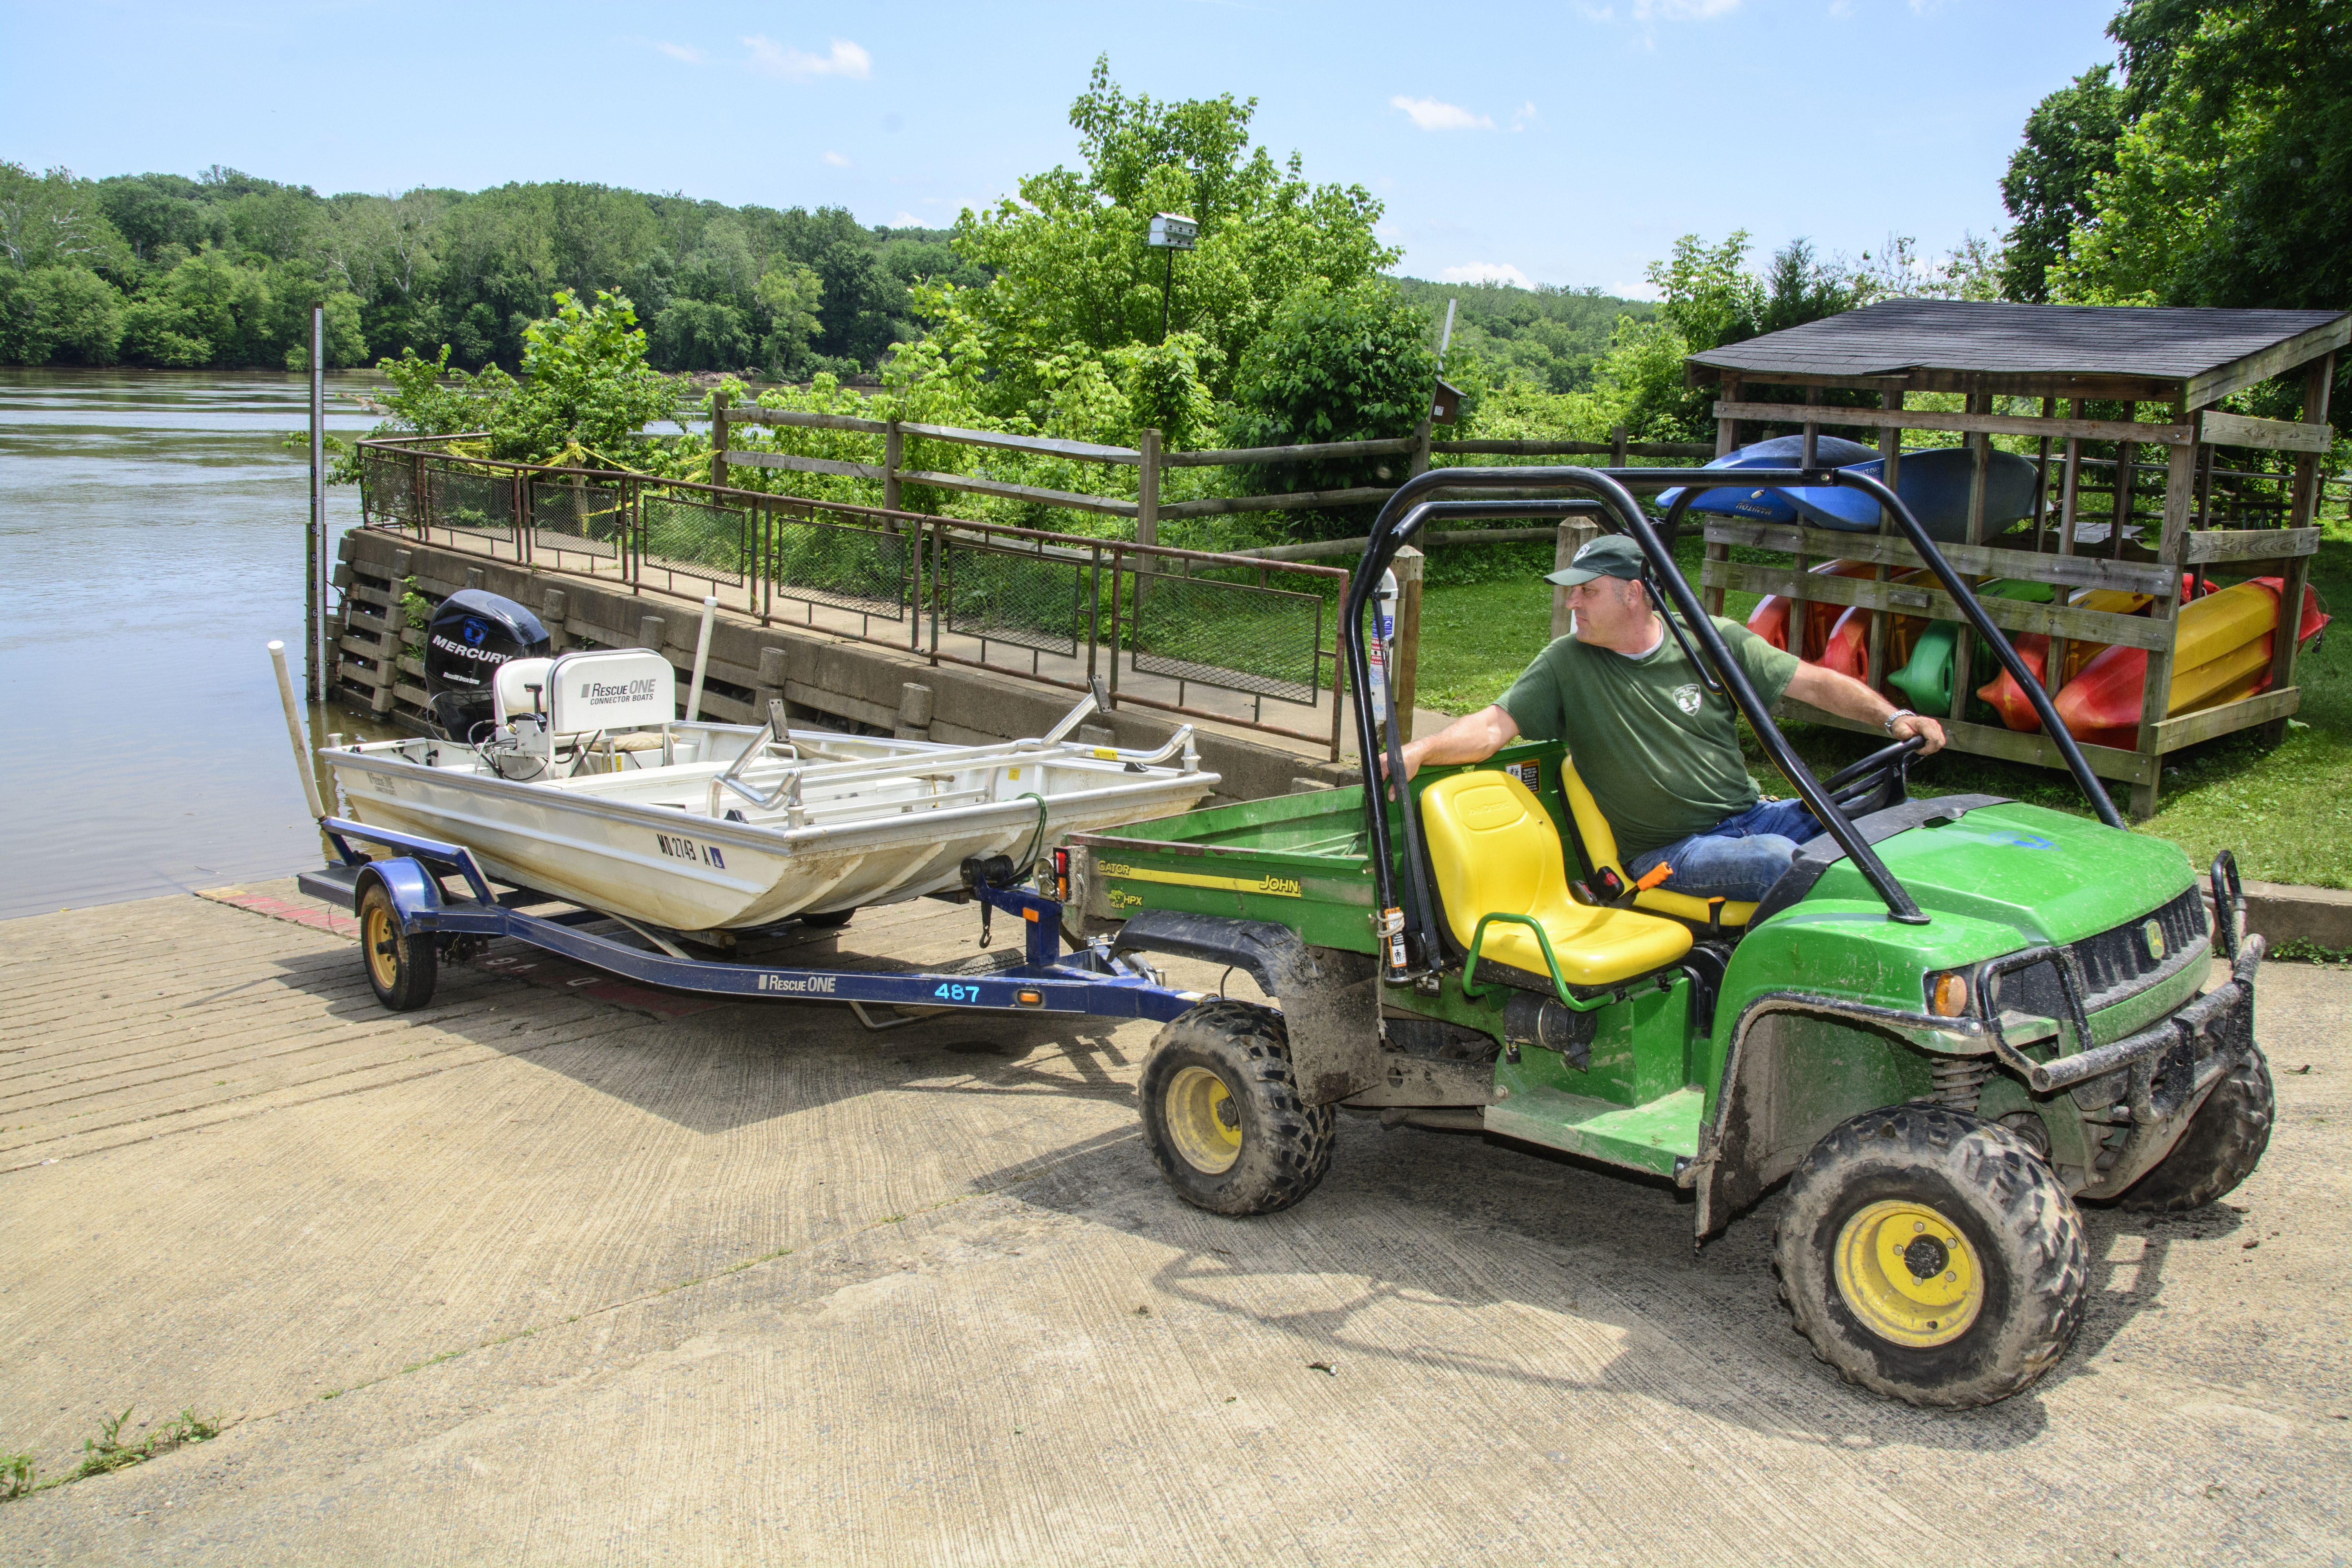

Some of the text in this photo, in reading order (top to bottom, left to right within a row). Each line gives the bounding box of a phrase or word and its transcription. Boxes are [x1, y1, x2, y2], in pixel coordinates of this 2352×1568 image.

[432, 634, 514, 664] MERCURY
[590, 693, 653, 705] CONNECTOR BOATS
[657, 833, 711, 866] MD 2743 A
[1098, 860, 1129, 875] GATOR
[1259, 875, 1298, 893] JOHN
[1123, 895, 1143, 906] HPX
[935, 983, 980, 1003] 487
